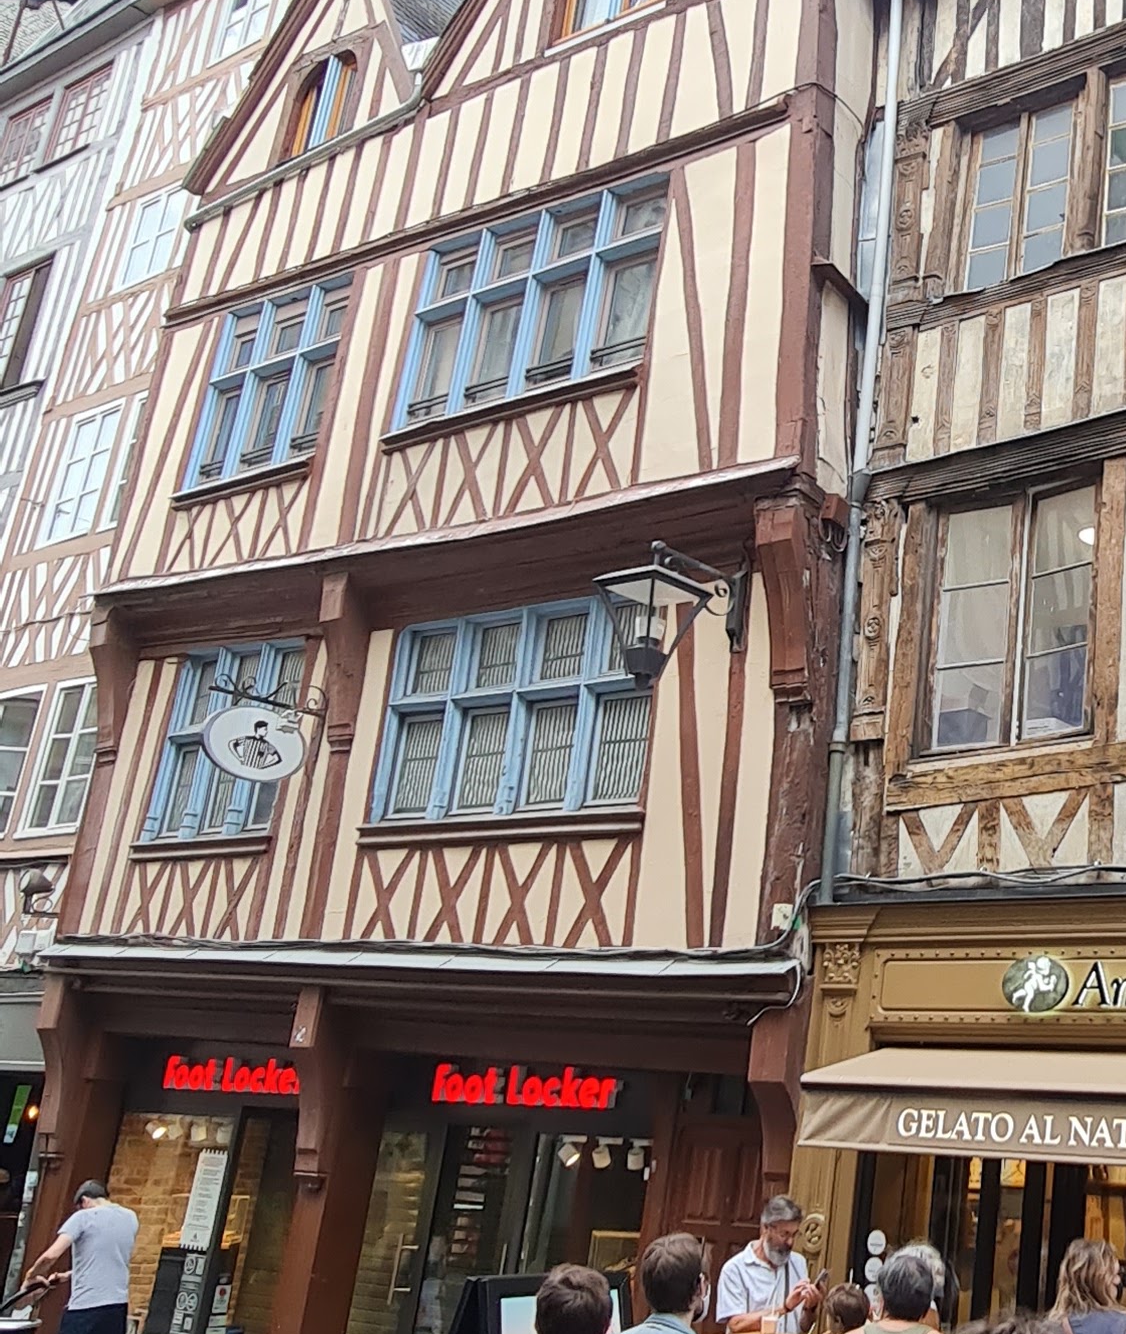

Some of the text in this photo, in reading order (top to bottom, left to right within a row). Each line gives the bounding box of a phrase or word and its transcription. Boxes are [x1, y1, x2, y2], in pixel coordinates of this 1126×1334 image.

[163, 1055, 299, 1095] Foot Locke
[432, 1063, 620, 1110] Foot Locker
[898, 1108, 1015, 1143] GELATO
[1019, 1114, 1062, 1146] AL
